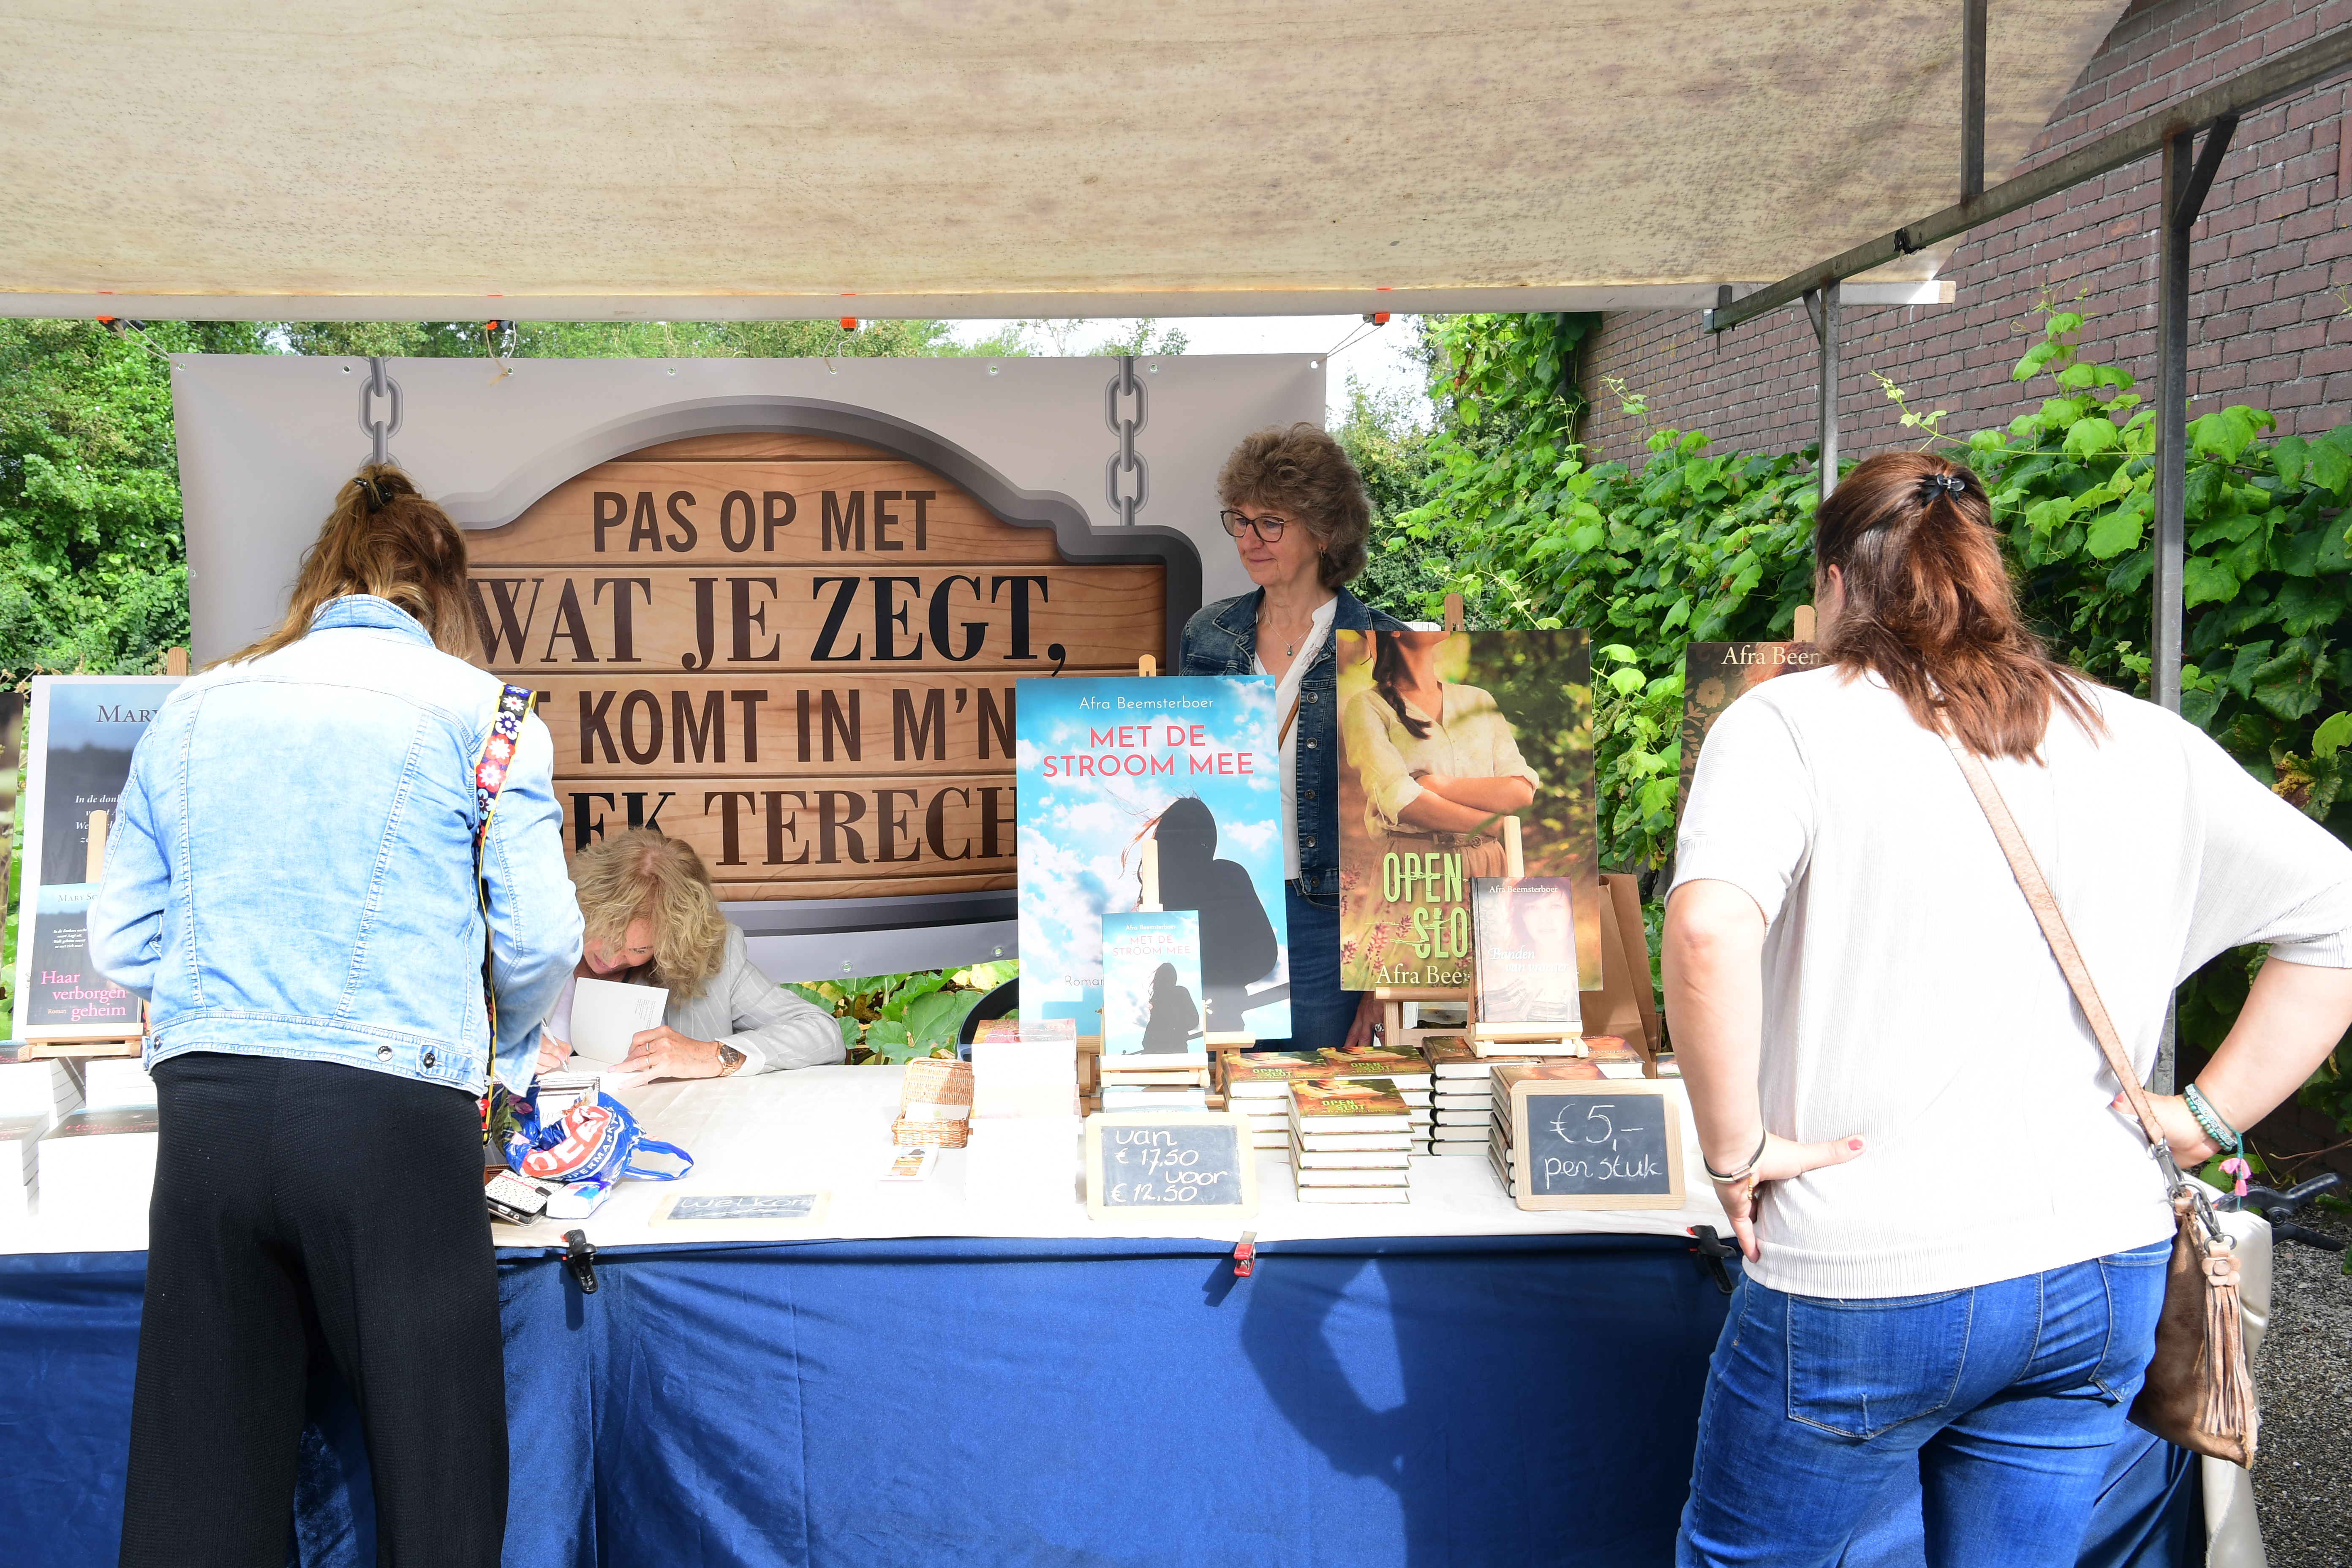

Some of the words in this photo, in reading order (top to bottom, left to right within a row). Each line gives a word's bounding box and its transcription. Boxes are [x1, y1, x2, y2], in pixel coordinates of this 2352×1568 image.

[593, 490, 698, 553] PAS
[720, 490, 797, 553] OP
[821, 490, 936, 551] MET
[467, 577, 651, 664] WAT
[681, 577, 781, 672] JE
[810, 575, 1067, 678] ZEGT,
[1720, 645, 1766, 664] Afra
[1079, 697, 1111, 710] Afra
[1117, 696, 1214, 709] Beemsterboer
[579, 689, 768, 765] KOMT
[797, 689, 860, 762] IN
[893, 688, 1016, 761] M'N
[1090, 725, 1152, 749] MET
[1166, 724, 1206, 747] DE
[1043, 754, 1174, 778] STROOM
[1190, 752, 1254, 776] MEE
[87, 795, 98, 803] de
[1383, 852, 1462, 902] OPEN
[1489, 885, 1505, 893] Afra
[1508, 885, 1558, 893] Beemsterboer
[1130, 936, 1152, 944] MET
[1159, 935, 1173, 943] DE
[1113, 946, 1161, 956] STROOM
[1167, 946, 1190, 954] MEE
[1487, 945, 1535, 960] Banden
[41, 970, 80, 984] Haar
[1375, 964, 1420, 984] Afra
[1425, 965, 1464, 984] Bee
[1505, 964, 1525, 972] van
[1528, 963, 1569, 978] vroeger
[52, 985, 126, 1004] verborgen
[71, 1002, 126, 1022] geheim
[1116, 1130, 1177, 1146] van
[1598, 1153, 1663, 1180] stuk
[1165, 1170, 1228, 1186] voor
